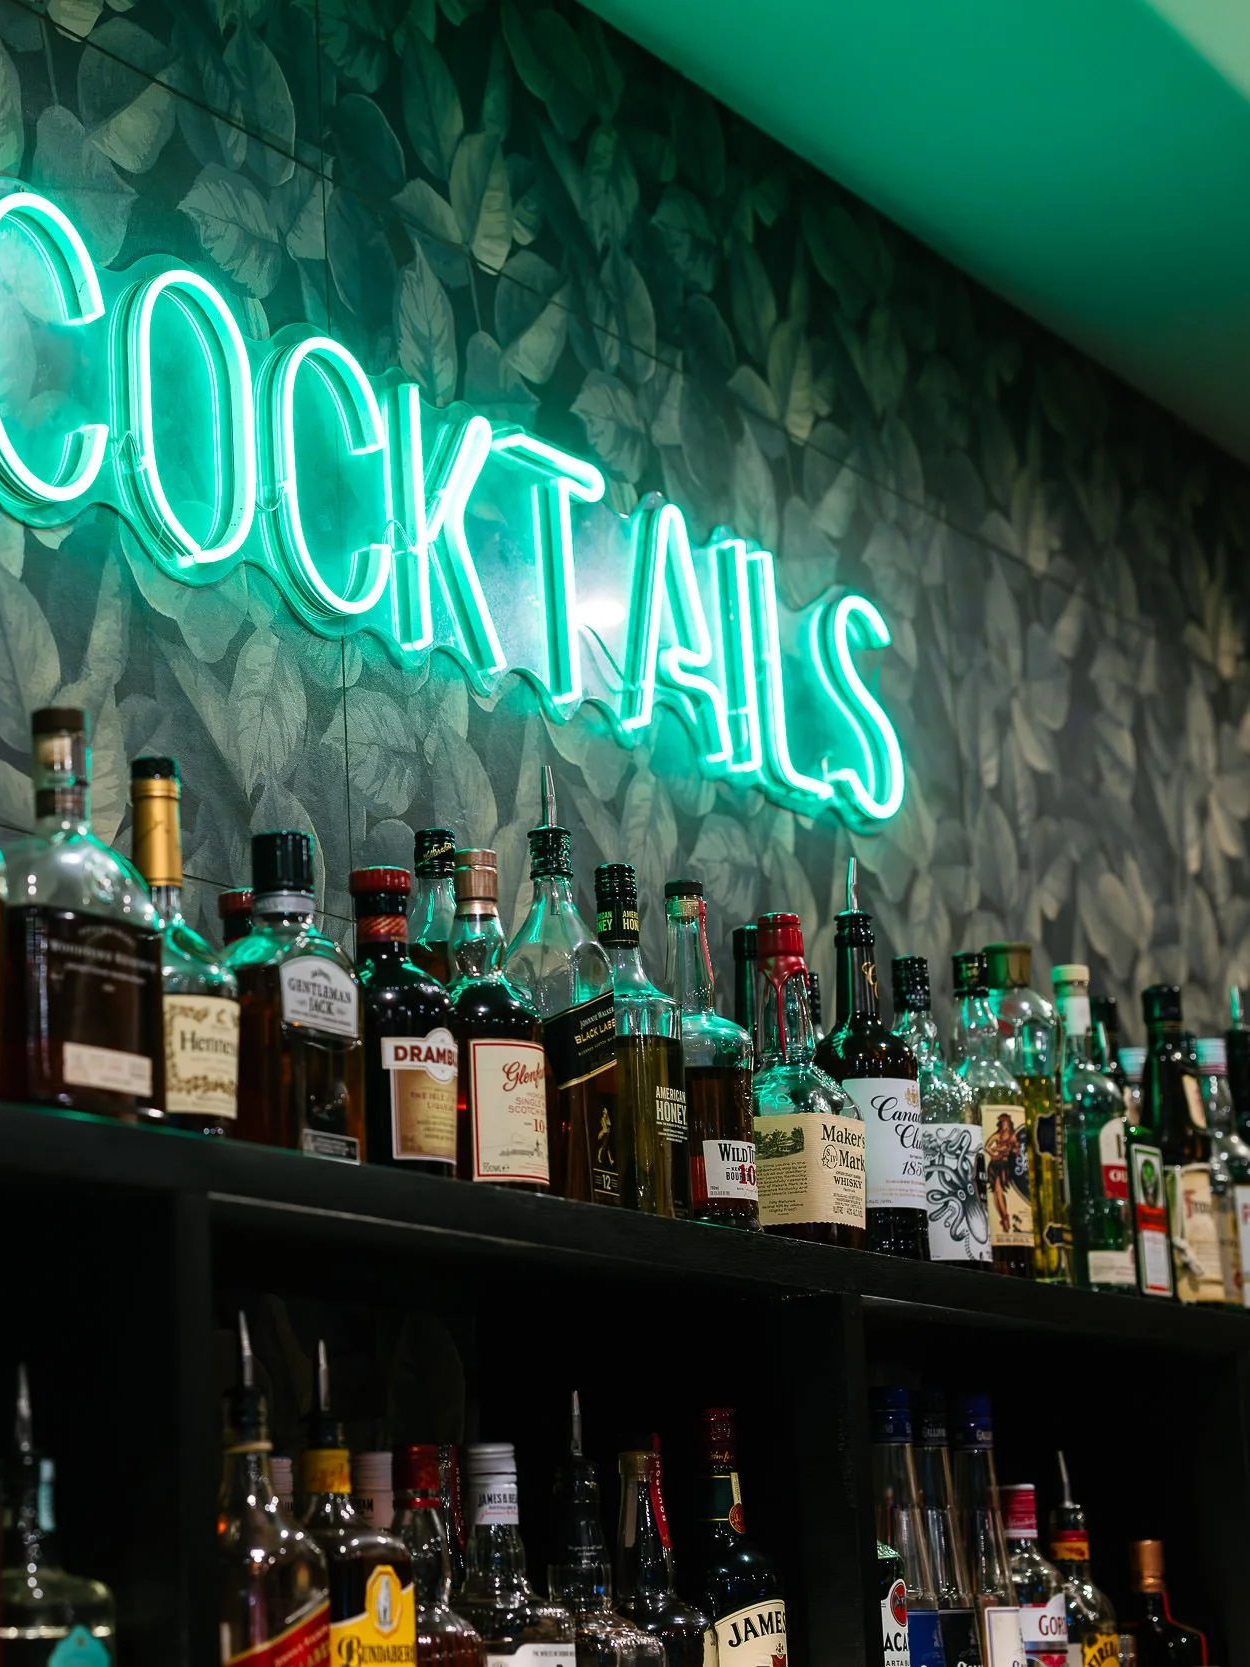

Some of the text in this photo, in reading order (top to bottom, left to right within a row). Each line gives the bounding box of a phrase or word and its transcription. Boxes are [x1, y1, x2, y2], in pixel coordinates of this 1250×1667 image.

[288, 977, 352, 1004] GENTLEMAN
[309, 997, 335, 1016] JACK
[574, 1027, 599, 1045] BLACK
[516, 1096, 542, 1108] SINGLE
[655, 1085, 687, 1104] AMERICAN
[655, 1099, 687, 1126] HONEY
[821, 1123, 866, 1150] Maker's
[717, 1142, 748, 1163] WILD
[838, 1149, 867, 1172] Mark
[602, 1173, 612, 1190] 12
[833, 1175, 863, 1190] WHISKY
